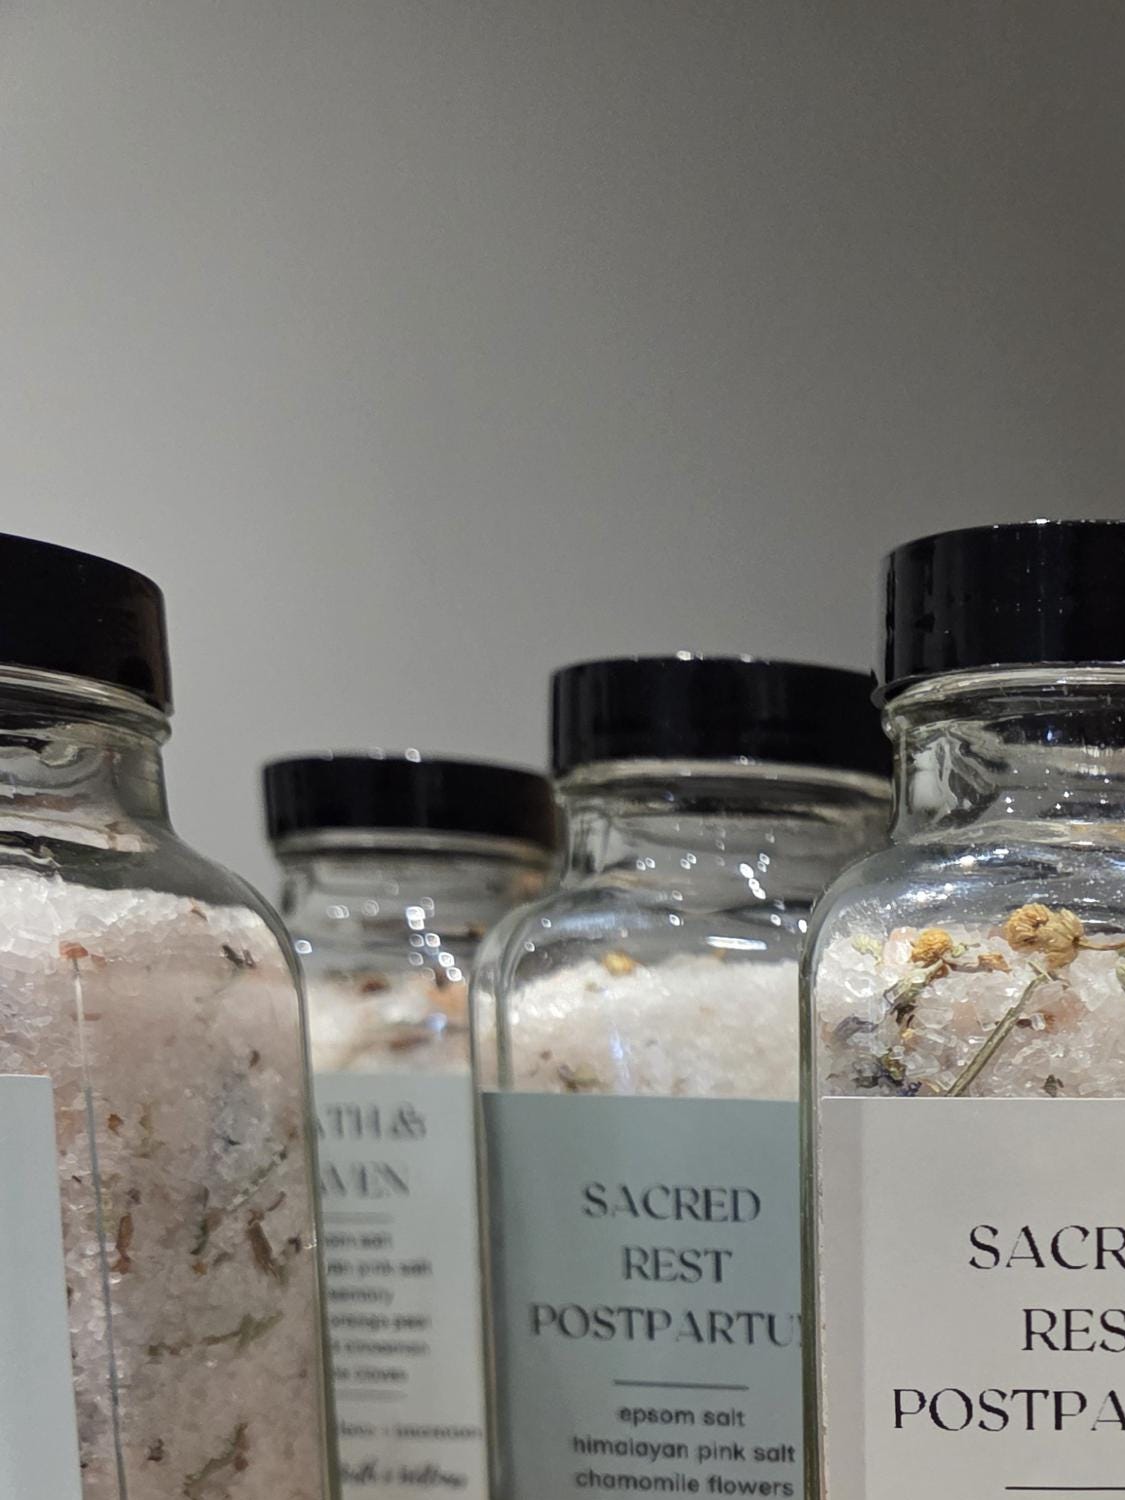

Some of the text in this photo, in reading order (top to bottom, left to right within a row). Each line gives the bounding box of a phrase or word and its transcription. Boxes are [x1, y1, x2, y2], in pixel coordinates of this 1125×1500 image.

[582, 1182, 761, 1223] SACRED
[623, 1246, 733, 1284] REST
[531, 1304, 802, 1347] POSTPARTU
[616, 1406, 746, 1428] epsom salt
[572, 1435, 796, 1465] himalayan pink salt
[574, 1469, 795, 1497] chamomile flowers
